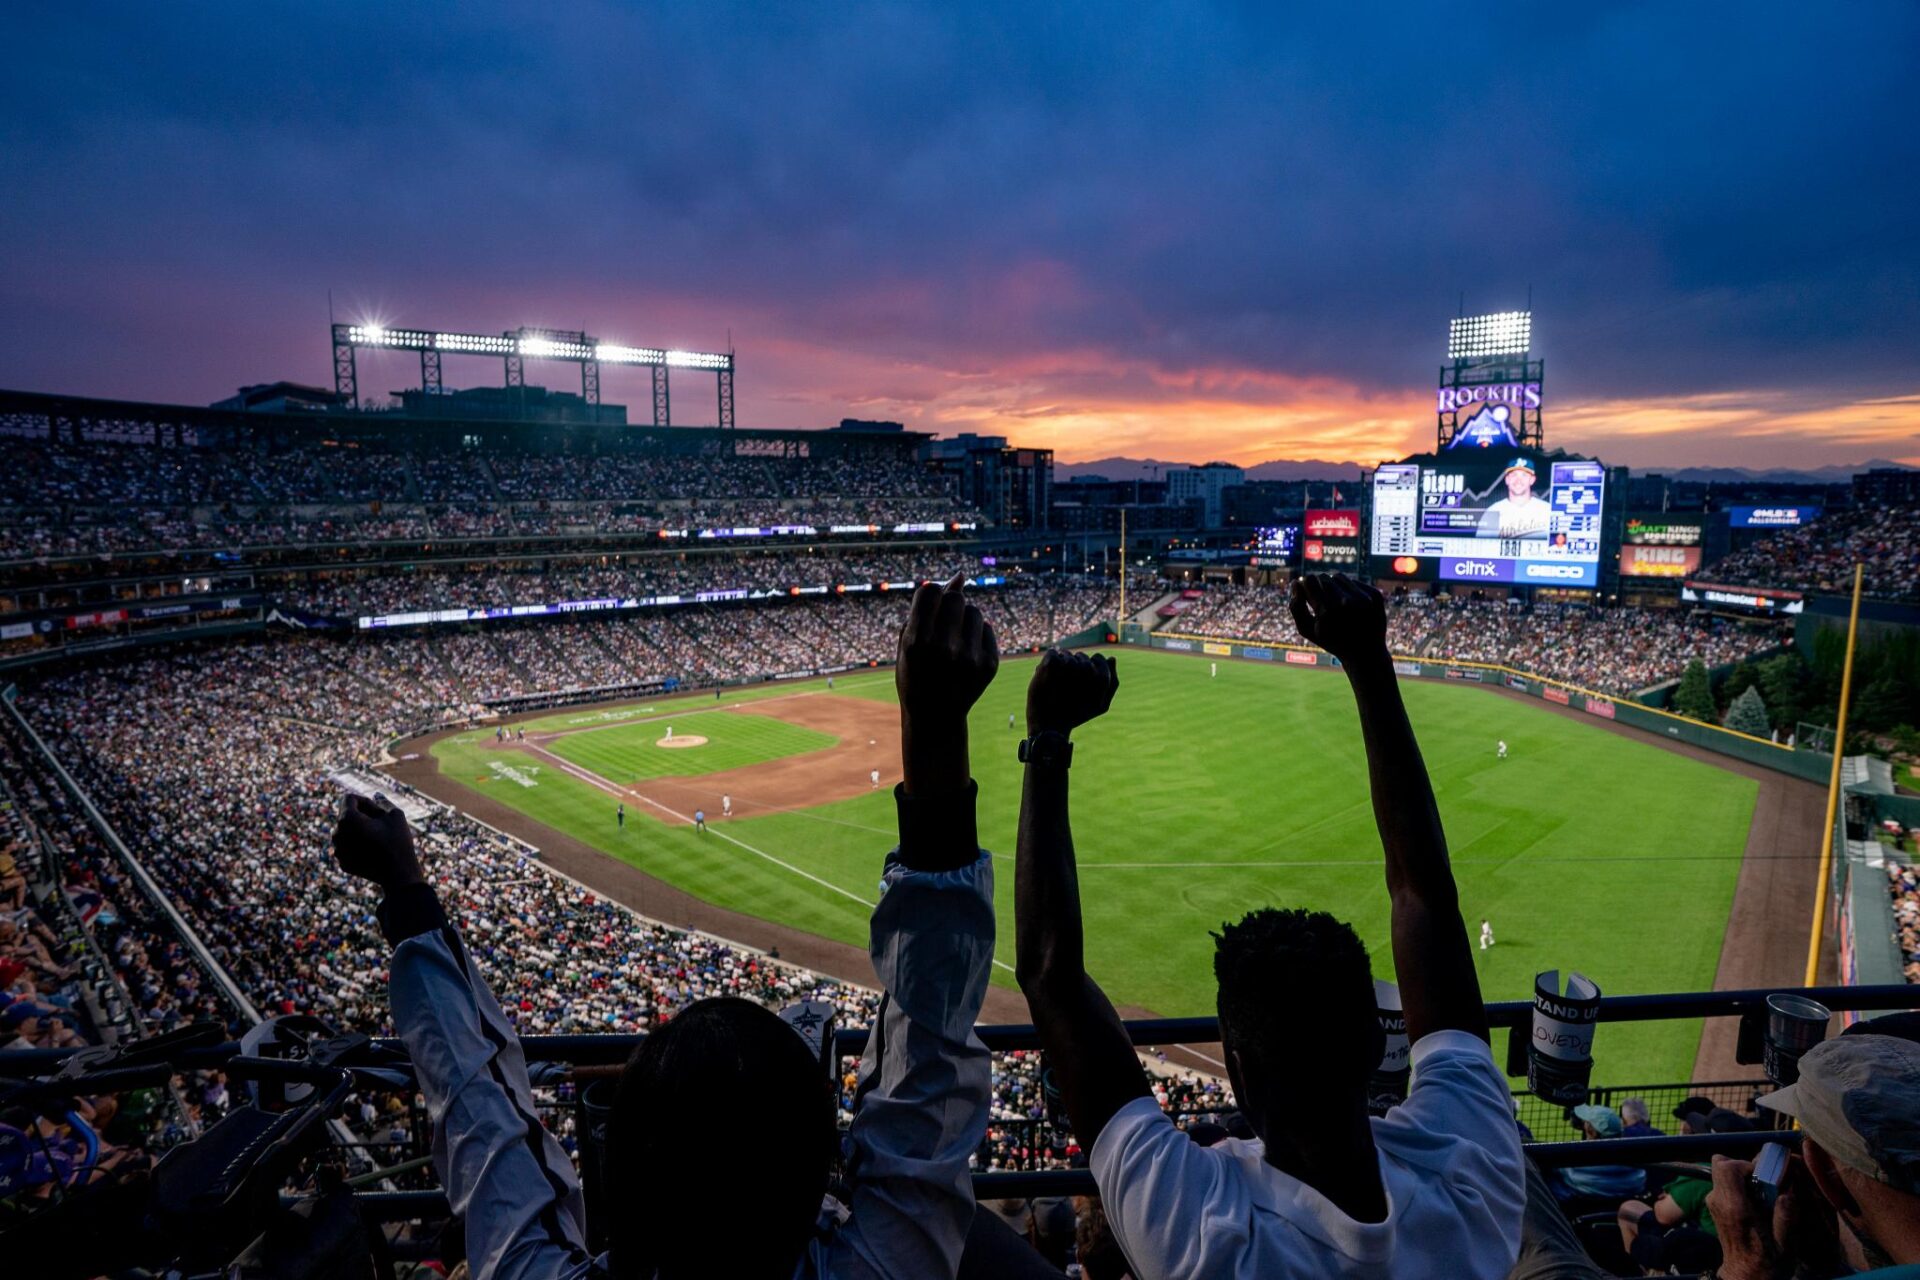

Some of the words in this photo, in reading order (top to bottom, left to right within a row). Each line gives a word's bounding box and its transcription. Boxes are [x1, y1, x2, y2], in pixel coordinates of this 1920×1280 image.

[1437, 383, 1540, 413] ROCKIES
[1423, 475, 1464, 493] OLSON
[1322, 546, 1357, 556] TOYOTA
[1634, 547, 1686, 563] KING
[1257, 558, 1286, 566] TUNDRA
[1526, 564, 1584, 578] GEICO
[222, 599, 242, 609] FOX
